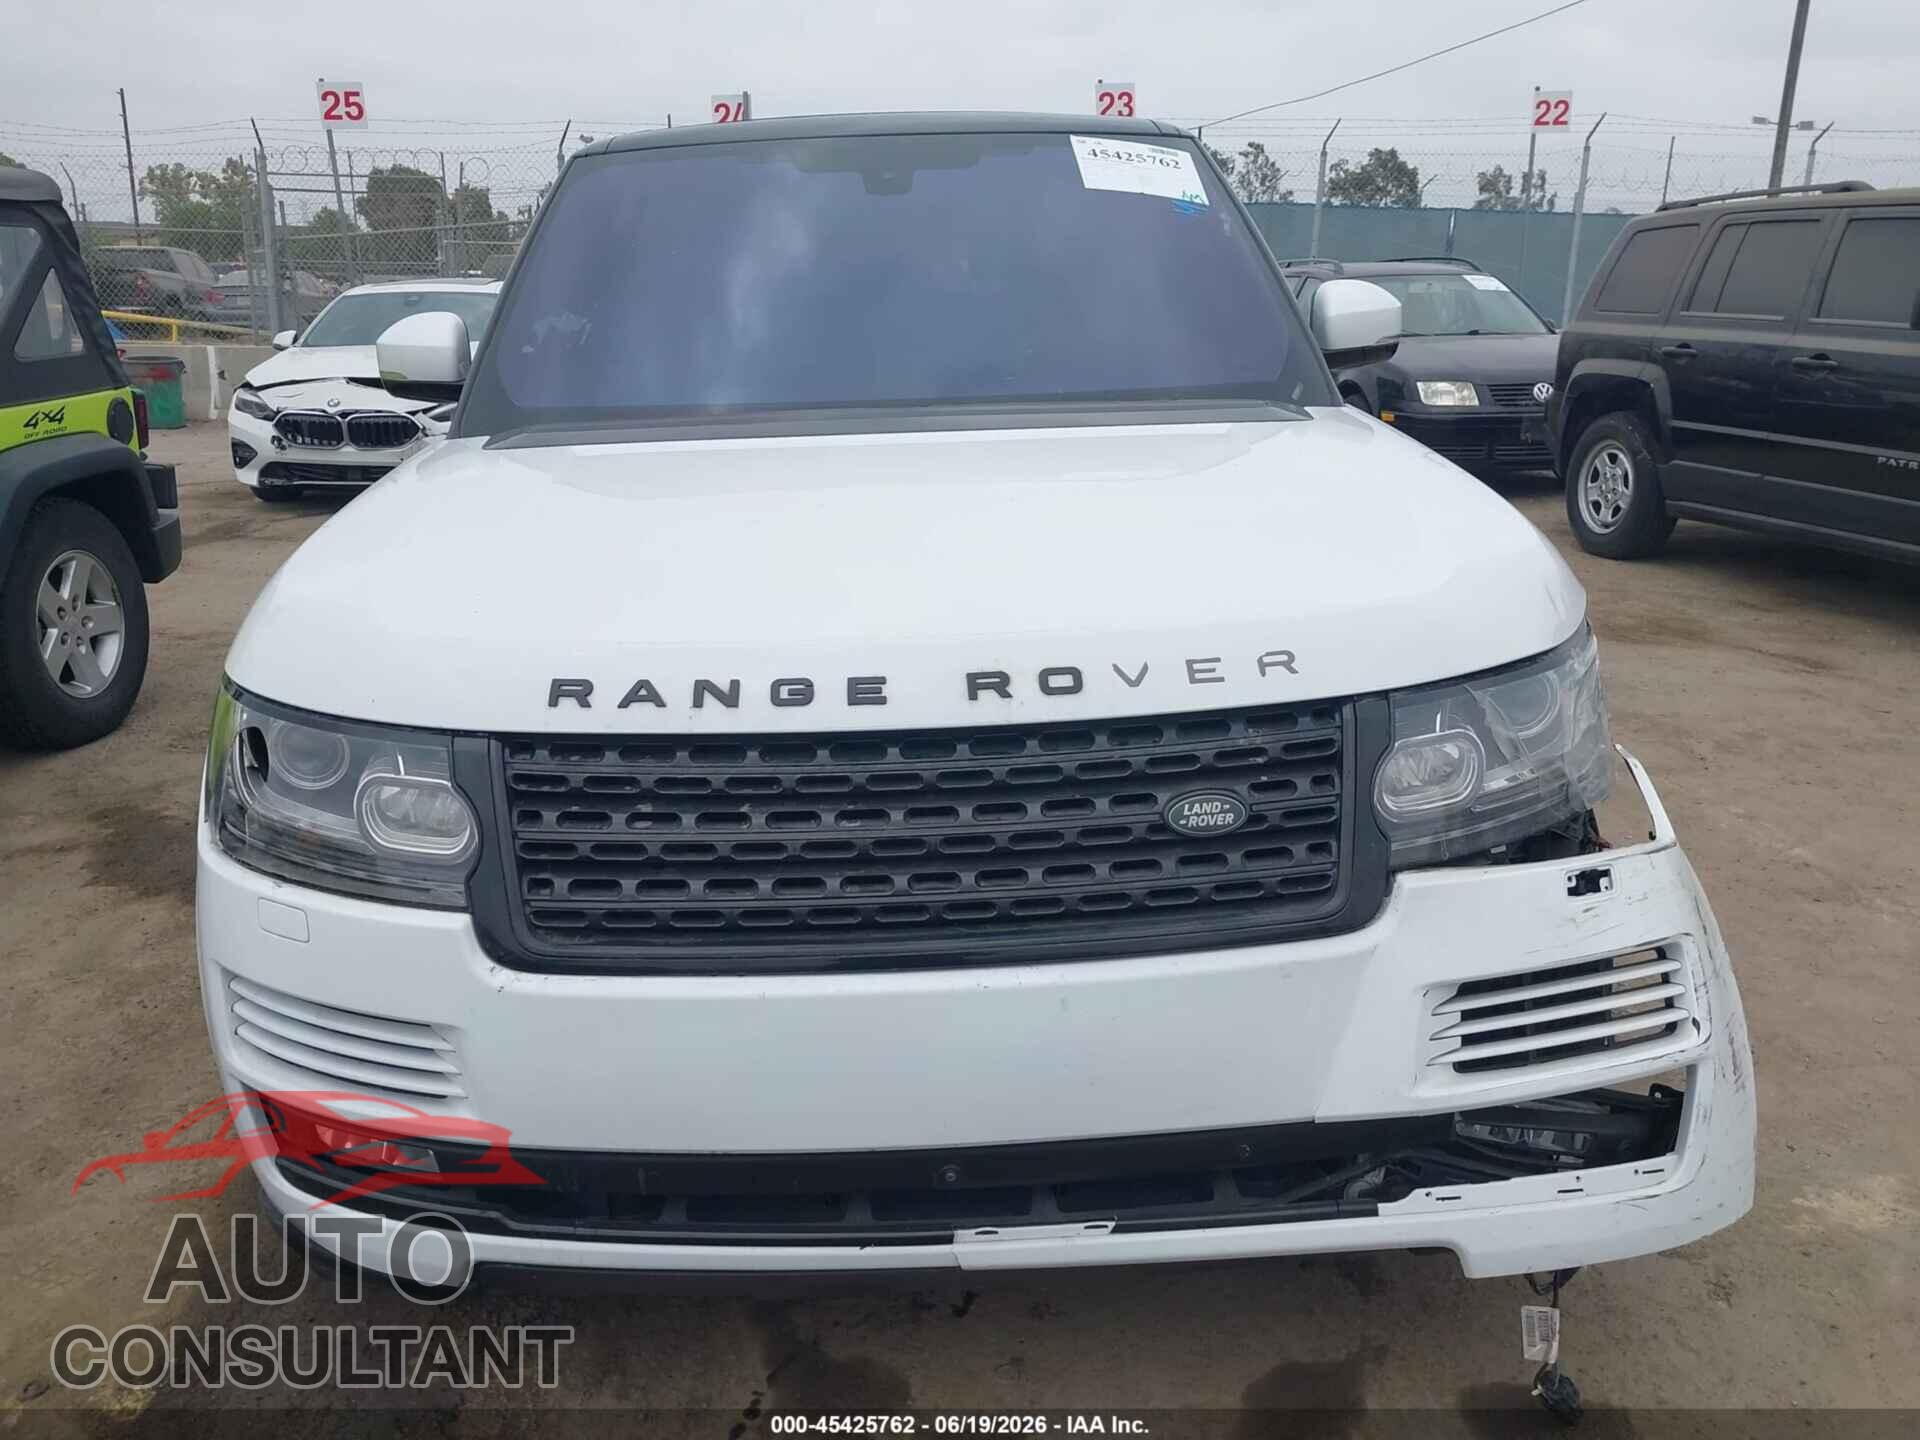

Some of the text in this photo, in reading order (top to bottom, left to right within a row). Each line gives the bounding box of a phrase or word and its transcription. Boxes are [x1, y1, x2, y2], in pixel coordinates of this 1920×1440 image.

[321, 91, 364, 121] 25
[1099, 91, 1133, 117] 23
[1535, 99, 1569, 126] 22
[1087, 148, 1182, 170] 45425762
[547, 649, 1299, 709] RANGE ROVER
[1183, 801, 1222, 816] LAND
[1187, 813, 1235, 828] ROVER
